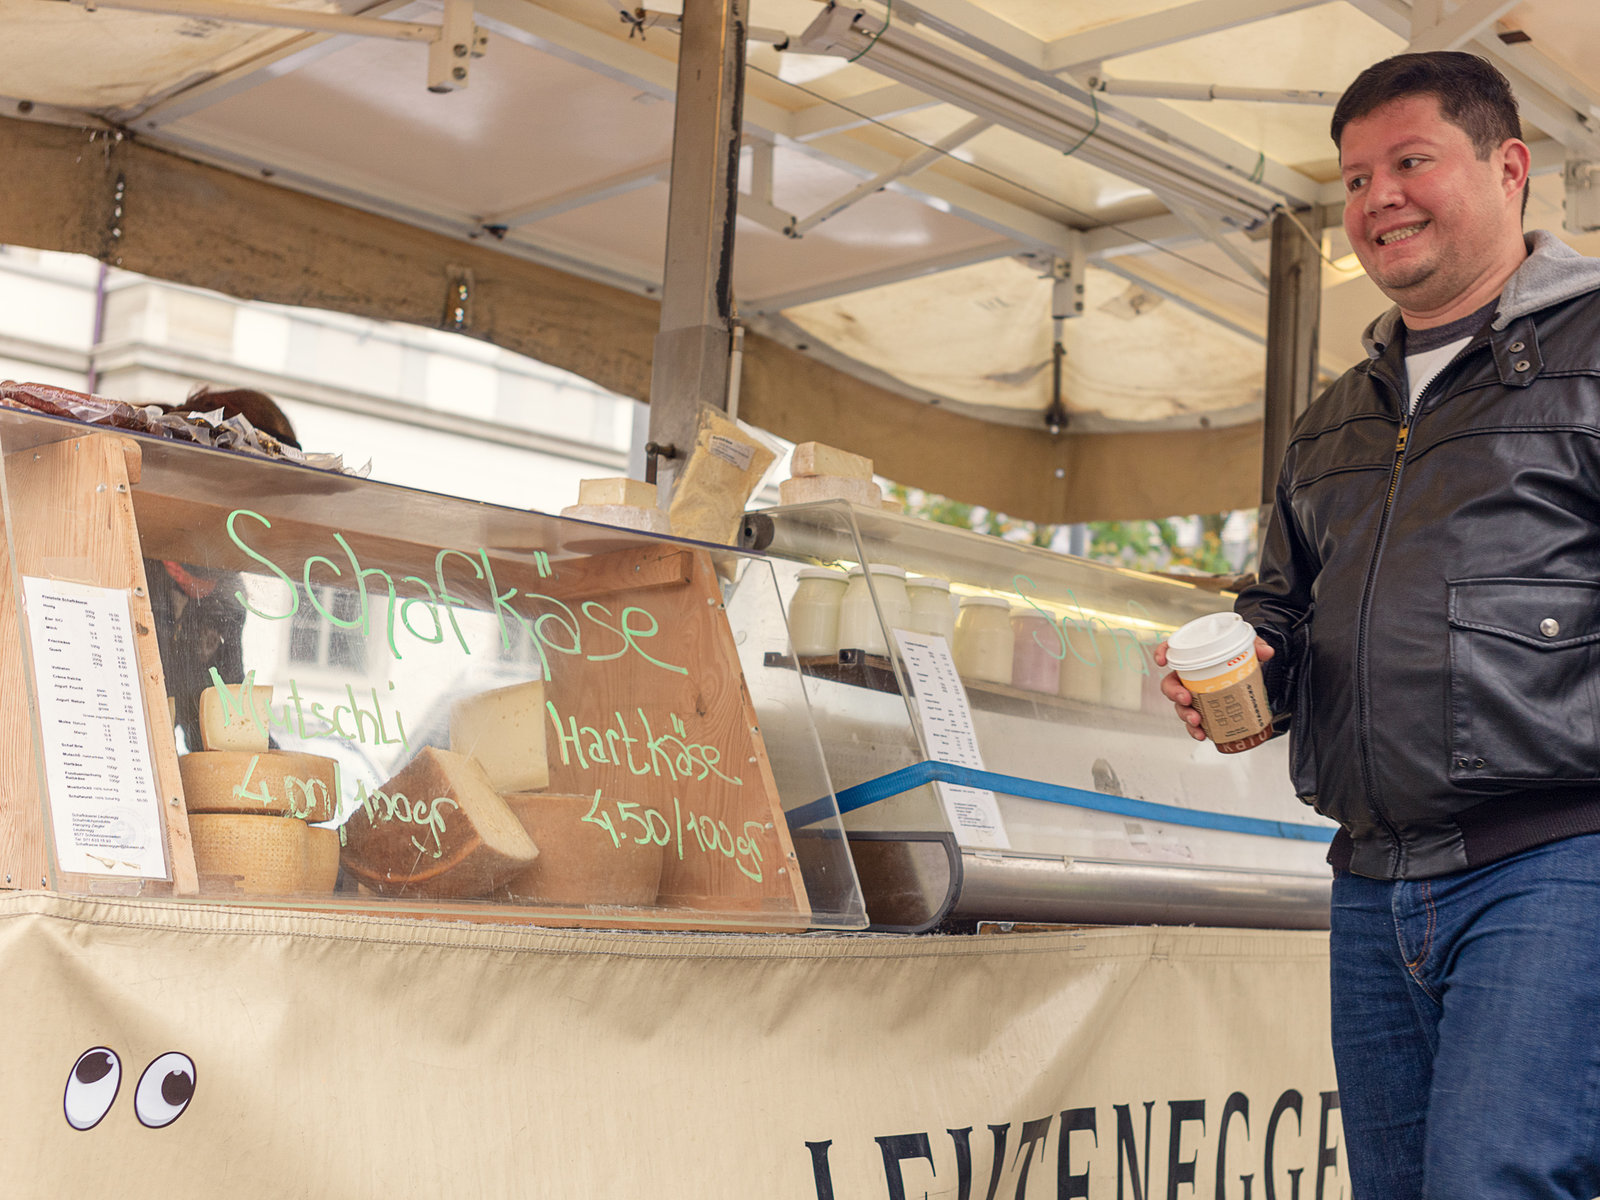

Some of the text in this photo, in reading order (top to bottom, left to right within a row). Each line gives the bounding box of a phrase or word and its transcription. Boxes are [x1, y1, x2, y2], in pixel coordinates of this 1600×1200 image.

[226, 509, 688, 681] Schafkäse
[546, 700, 743, 786] Hartkäse
[581, 789, 765, 883] 4.50/100gr
